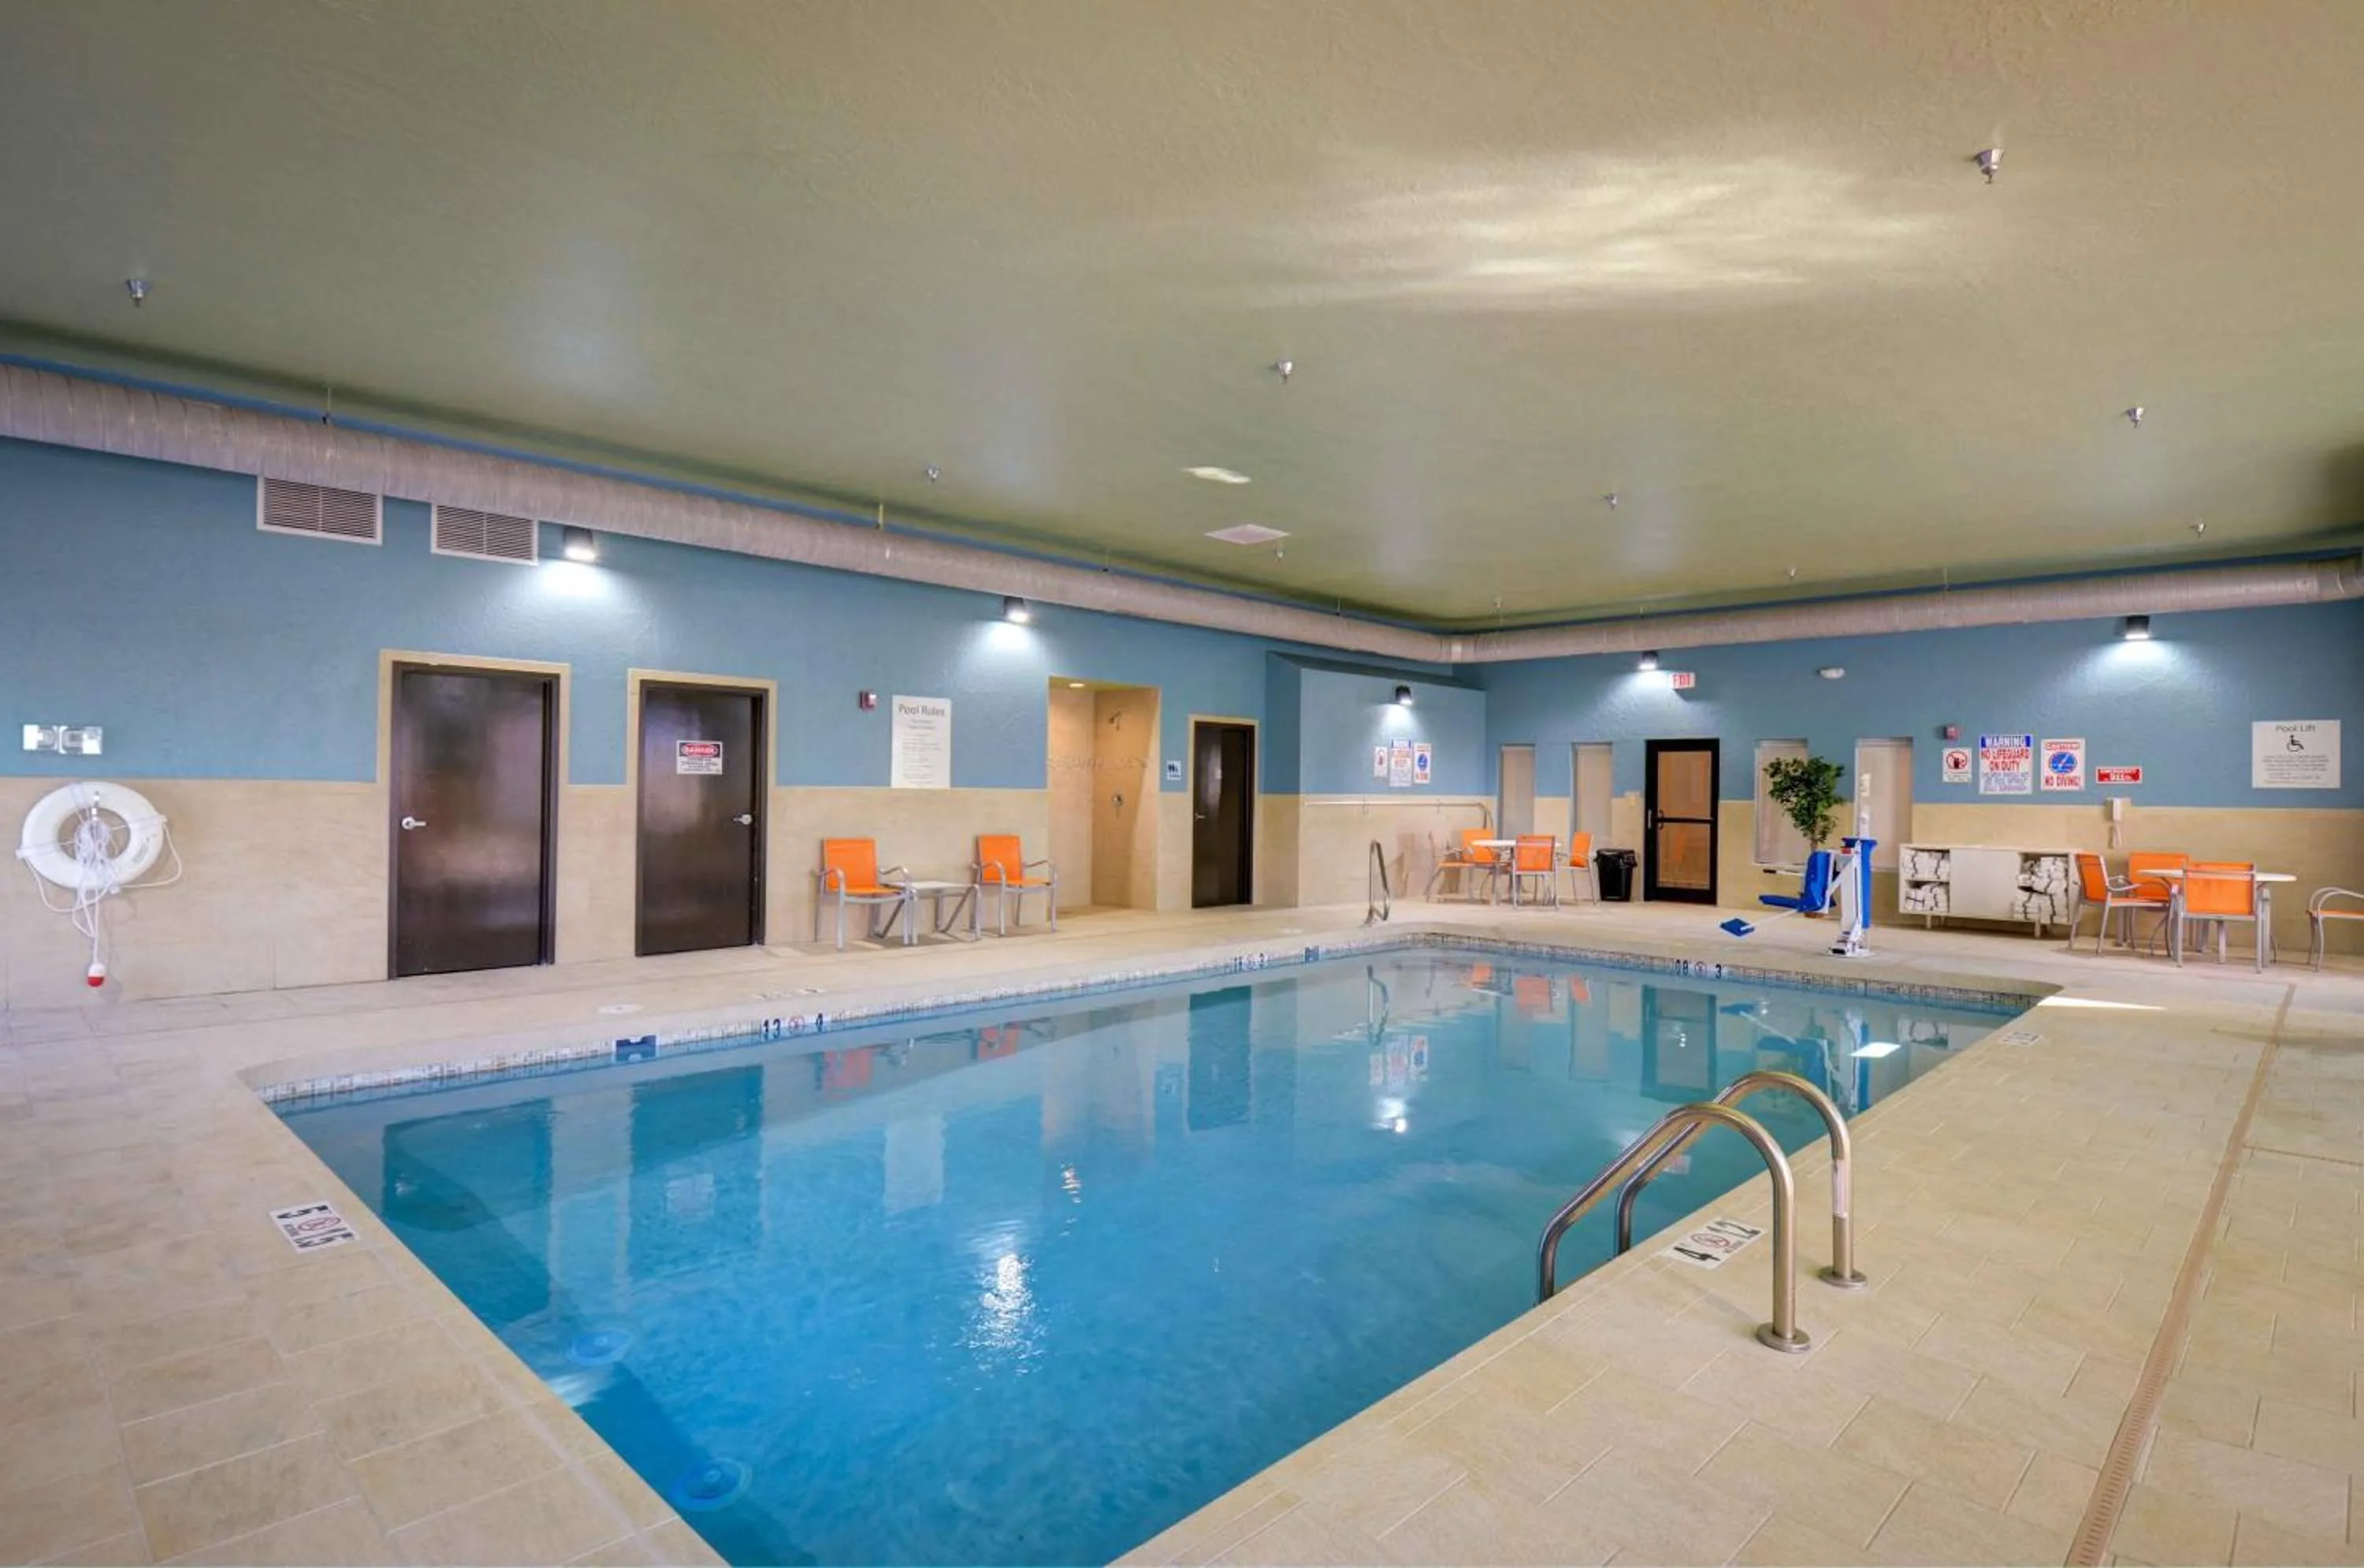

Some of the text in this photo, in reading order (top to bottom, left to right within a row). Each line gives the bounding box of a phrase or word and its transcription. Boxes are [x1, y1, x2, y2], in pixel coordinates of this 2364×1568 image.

[1673, 673, 1690, 687] EXIT
[899, 703, 946, 716] Pool Rules
[2276, 723, 2316, 733] Pool Lift
[1986, 735, 2026, 748] WARNING
[1980, 748, 2031, 760] NO LIFEGUARD
[1989, 760, 2020, 771] ON DUTY
[2044, 775, 2054, 786] NO
